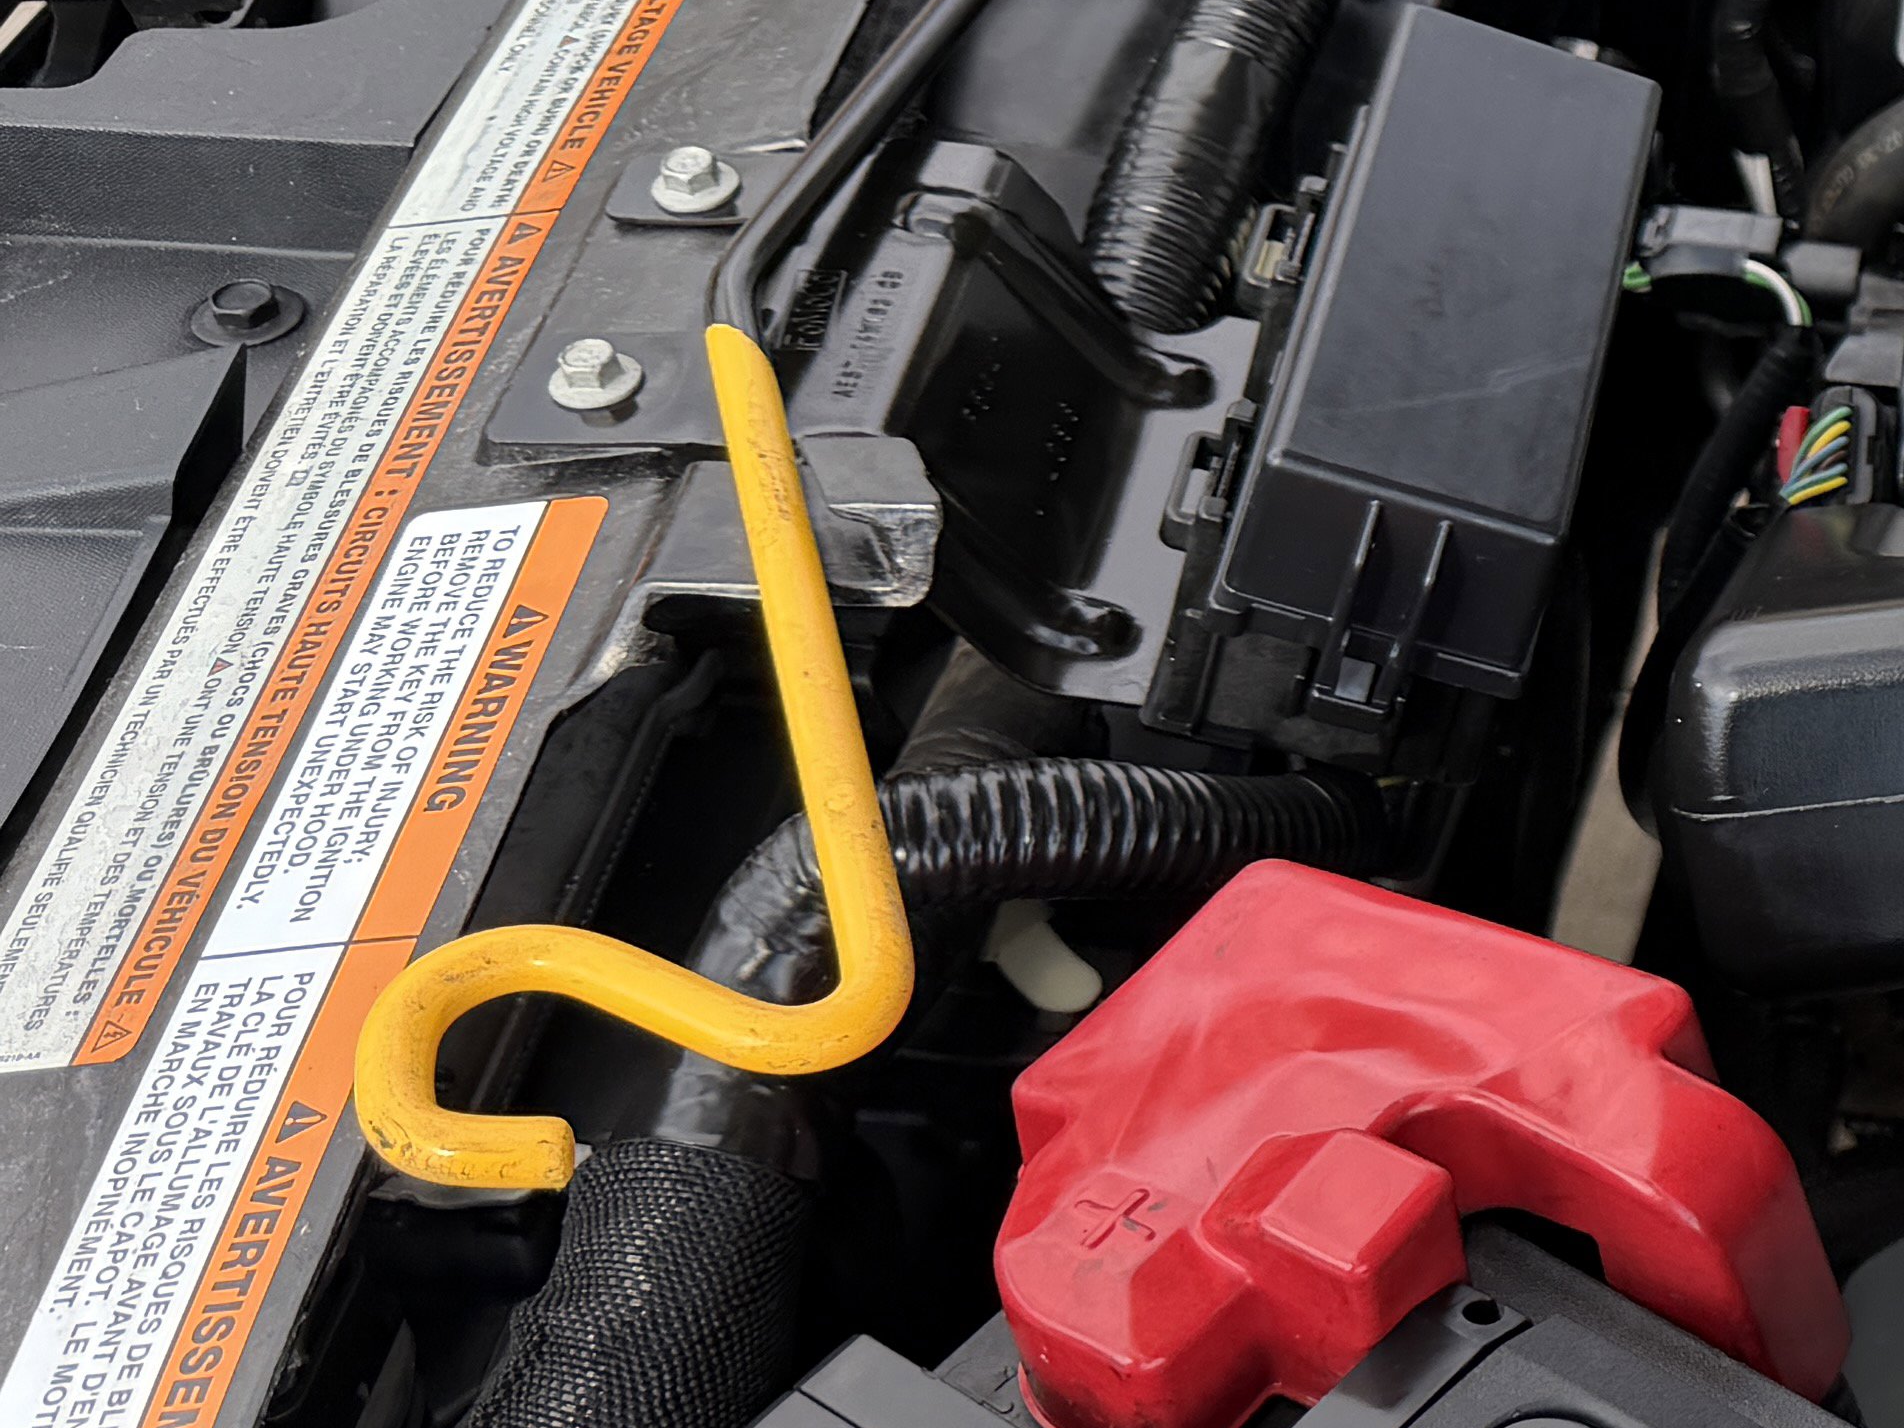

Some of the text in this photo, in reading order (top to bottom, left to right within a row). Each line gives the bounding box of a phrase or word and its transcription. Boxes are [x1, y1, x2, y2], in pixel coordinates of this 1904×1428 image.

[557, 60, 634, 151] VEHICLE
[381, 253, 528, 480] AVERTISSEMENT
[312, 506, 392, 614] CIRCUITS
[268, 620, 334, 702] HAUTE
[280, 533, 462, 874] BEFORE WORKING UNDER HOOD.
[341, 525, 521, 865] TO REDUCE THE RISK OF INJURY;
[208, 708, 290, 820] TENSION
[234, 536, 432, 909] ENGINE MAY START UNEXPECTEDLY.
[287, 529, 491, 922] REMOVE THE KEY FROM THE IGNITION
[422, 639, 534, 812] WARNING
[186, 827, 229, 863] DU
[113, 870, 213, 1006] VÉHICULE
[180, 978, 252, 1088] TRAVAUX
[226, 1011, 271, 1057] CLÉ
[249, 975, 282, 1005] LA
[265, 971, 316, 1038] POUR
[145, 1095, 199, 1164] SOUS
[208, 1066, 242, 1098] DE
[213, 1045, 287, 1154] RÉDUIRE
[44, 982, 220, 1313] EN MARCHE INOPINÉMENT.
[128, 1172, 164, 1203] LE
[131, 1105, 225, 1268] L'ALLUMAGE
[187, 1162, 231, 1210] LES
[81, 1210, 147, 1305] CAPOT.
[132, 1218, 207, 1334] RISQUES
[61, 1321, 98, 1354] LE
[90, 1278, 148, 1360] AVANT
[114, 1344, 152, 1380] DE
